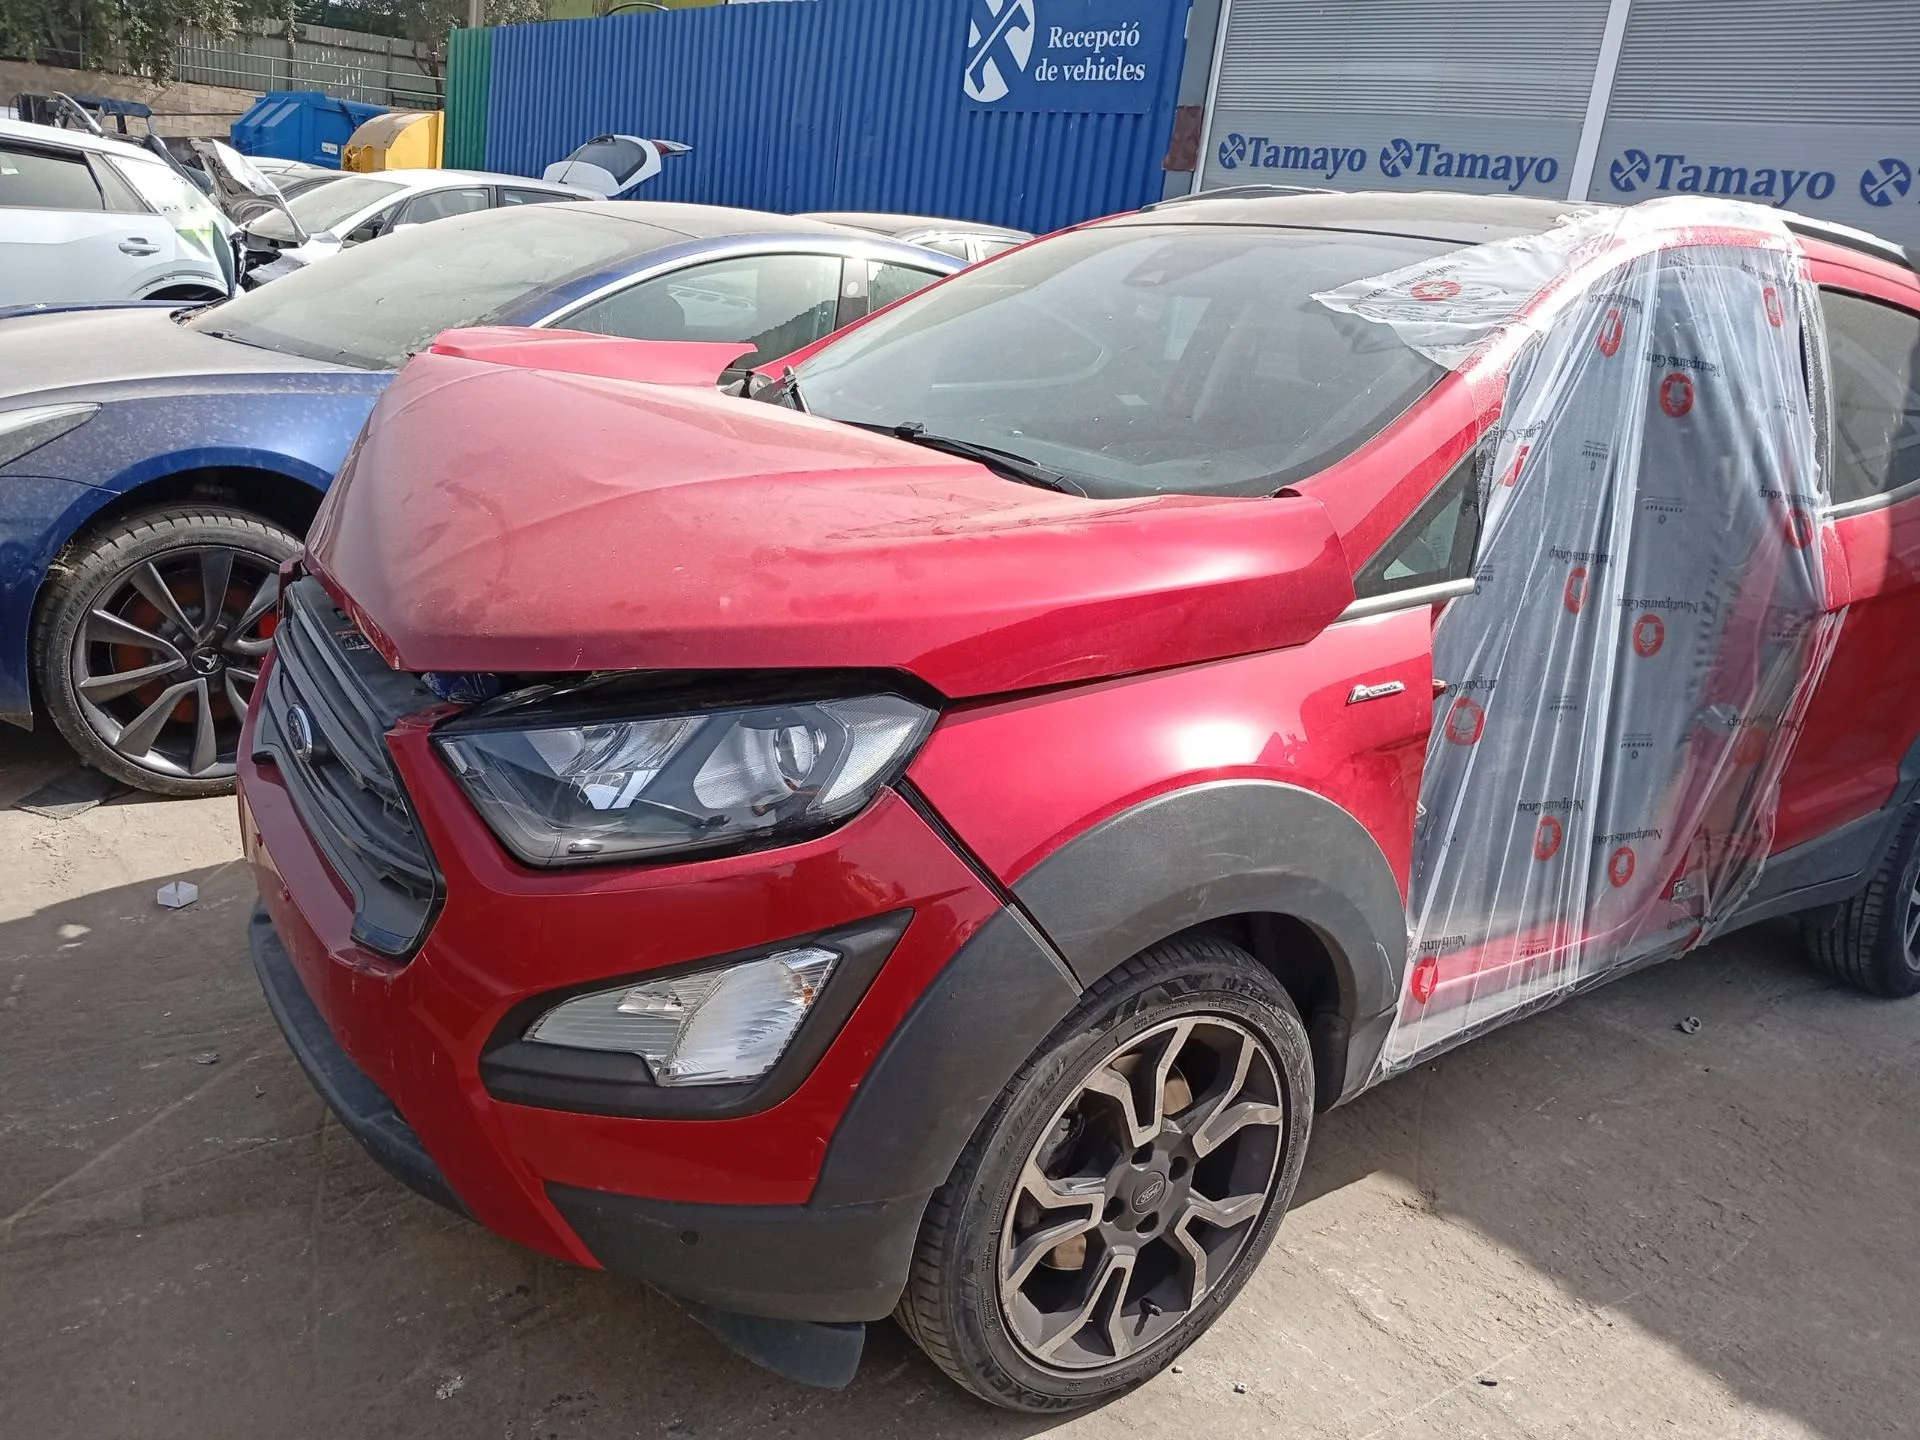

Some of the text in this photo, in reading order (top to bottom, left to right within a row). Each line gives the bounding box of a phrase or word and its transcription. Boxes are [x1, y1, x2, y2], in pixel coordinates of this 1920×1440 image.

[1047, 22, 1140, 53] Recepció
[1034, 56, 1146, 82] de vehicles
[1248, 137, 1367, 180] Tamayo
[1415, 143, 1558, 191] Tamayo
[1655, 154, 1836, 208] Tamayo
[1639, 596, 1699, 614] Nautipaints
[1615, 827, 1663, 844] Nautipaints
